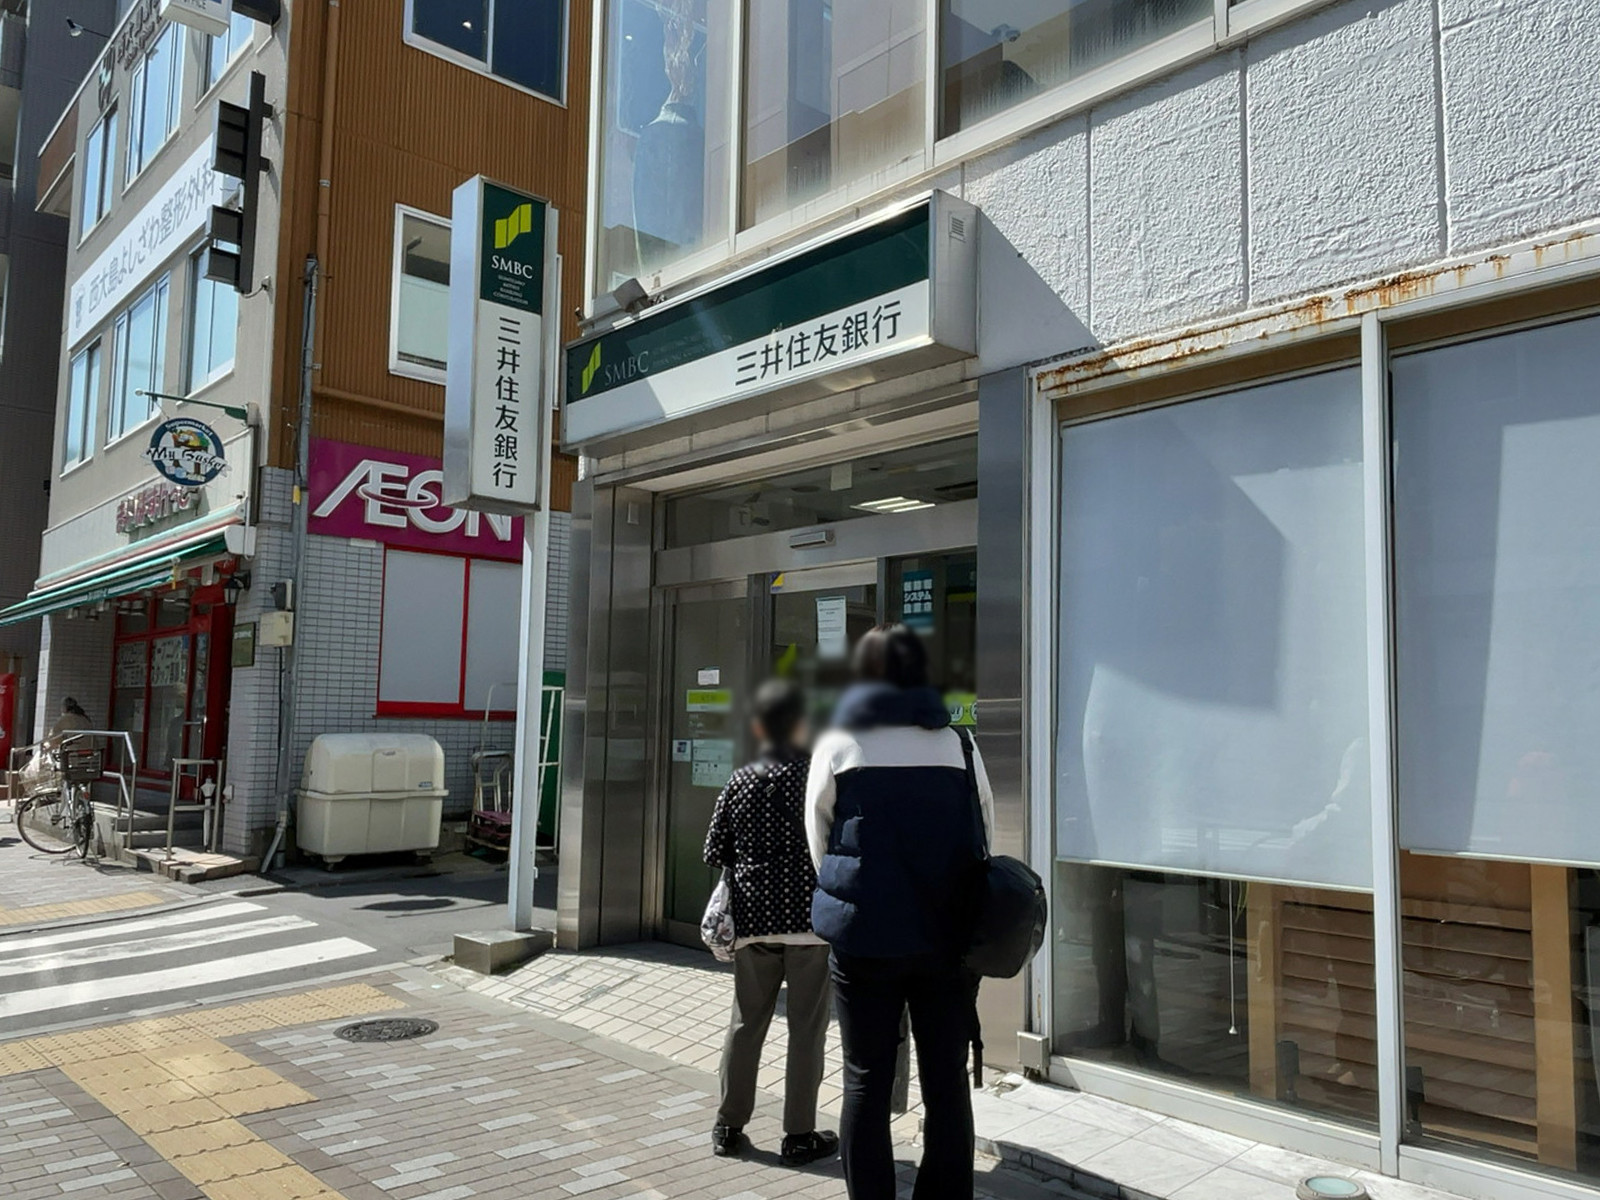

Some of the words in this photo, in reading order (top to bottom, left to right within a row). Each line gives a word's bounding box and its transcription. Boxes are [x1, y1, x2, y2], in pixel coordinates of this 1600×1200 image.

[88, 158, 216, 314] 西大島よしざわ整形外科
[491, 254, 533, 279] SMBC
[735, 300, 902, 386] 三井住友銀行
[604, 351, 649, 386] SMBC
[492, 316, 521, 489] 三井住友銀行
[165, 420, 214, 436] Supermarket
[146, 447, 176, 460] My
[181, 450, 225, 470] Basket
